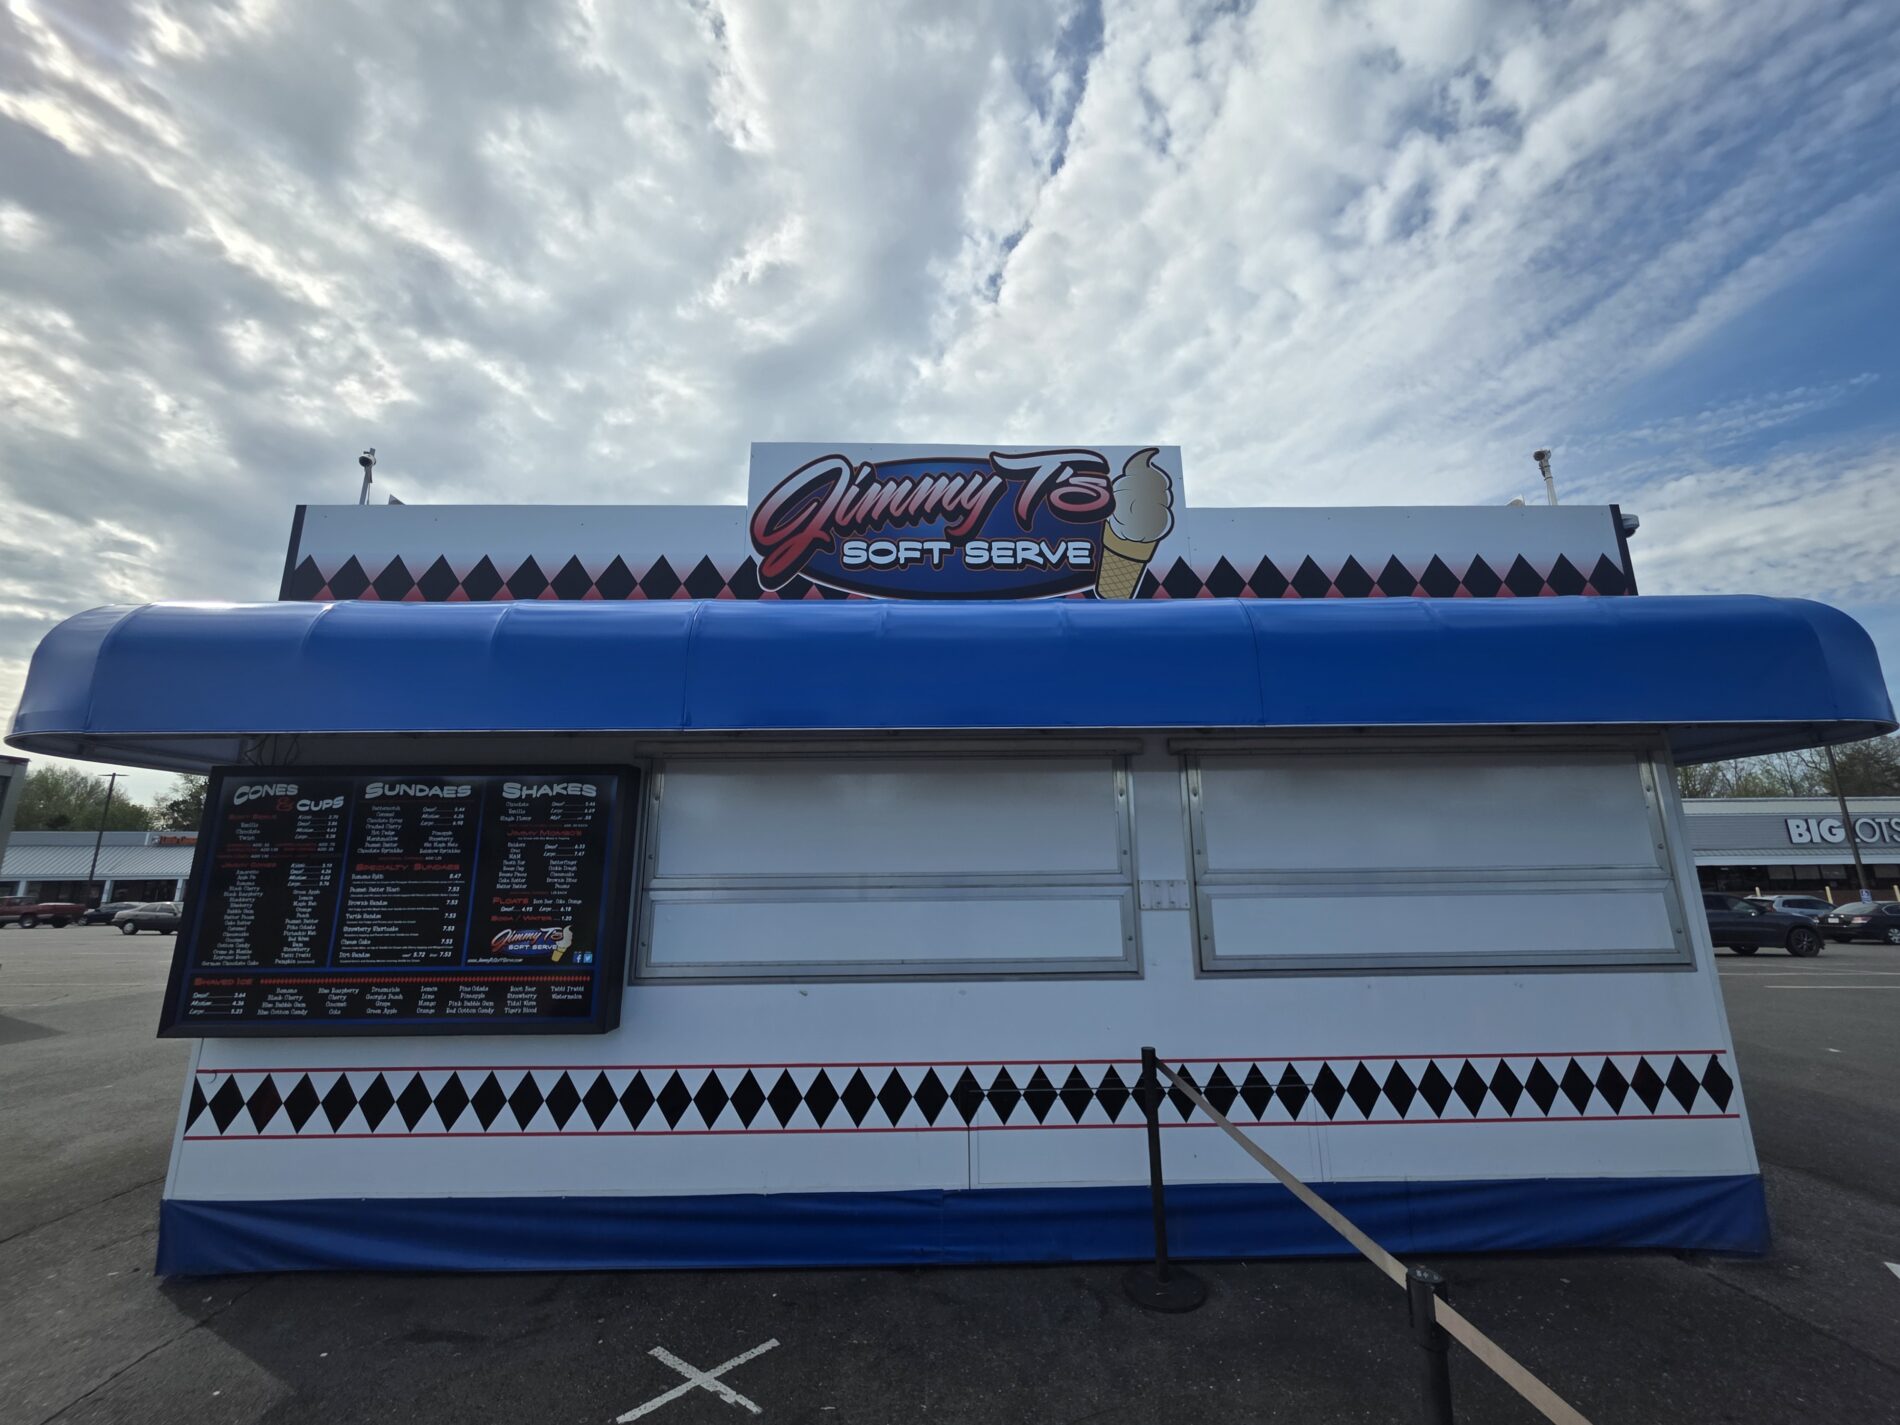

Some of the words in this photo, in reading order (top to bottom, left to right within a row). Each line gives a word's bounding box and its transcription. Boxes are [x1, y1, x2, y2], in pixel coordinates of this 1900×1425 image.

[752, 454, 1003, 578] Jimmy
[991, 450, 1112, 528] T's
[842, 541, 951, 565] SOFT
[964, 541, 1091, 565] SERVE
[234, 784, 298, 806] CONES
[365, 782, 472, 798] SUNDAES
[502, 782, 597, 799] SHAKES
[297, 796, 344, 811] CUPS
[1786, 818, 1846, 844] BIG
[1851, 817, 1900, 843] OTS
